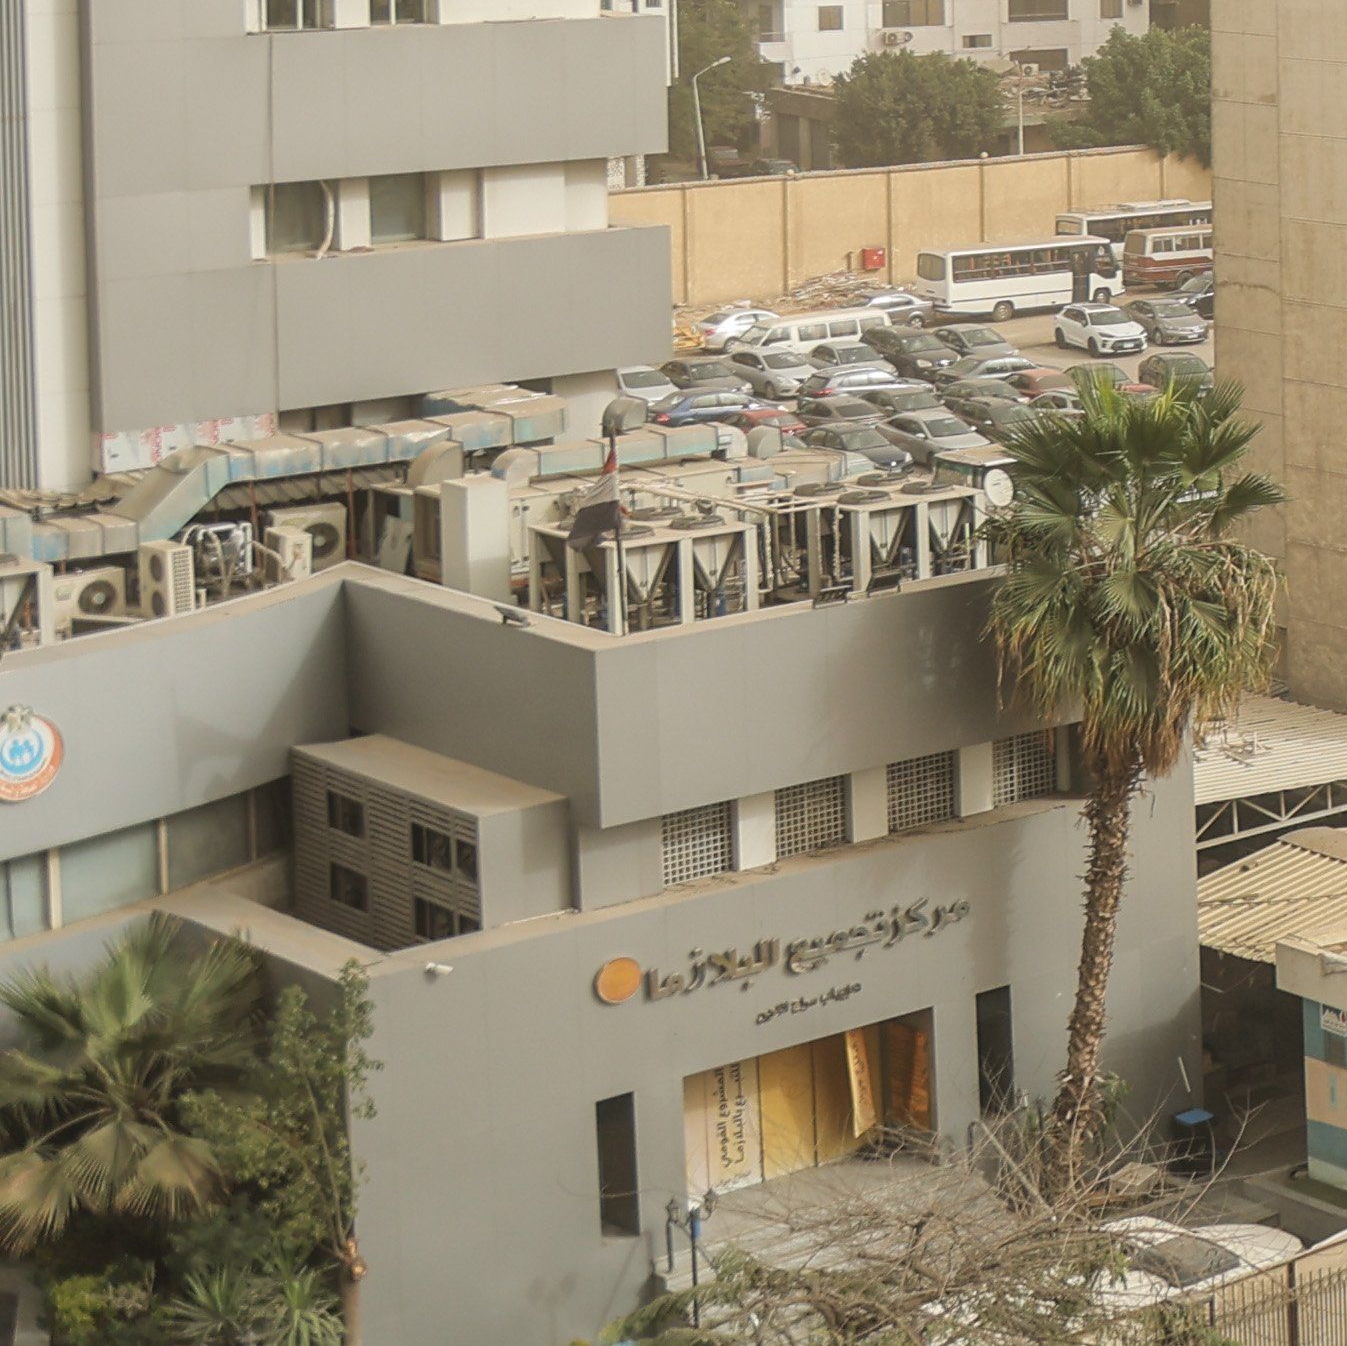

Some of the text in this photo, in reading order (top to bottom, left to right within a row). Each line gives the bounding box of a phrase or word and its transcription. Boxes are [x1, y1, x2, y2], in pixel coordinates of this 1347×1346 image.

[644, 897, 971, 1001] مركز تجميع البلازما
